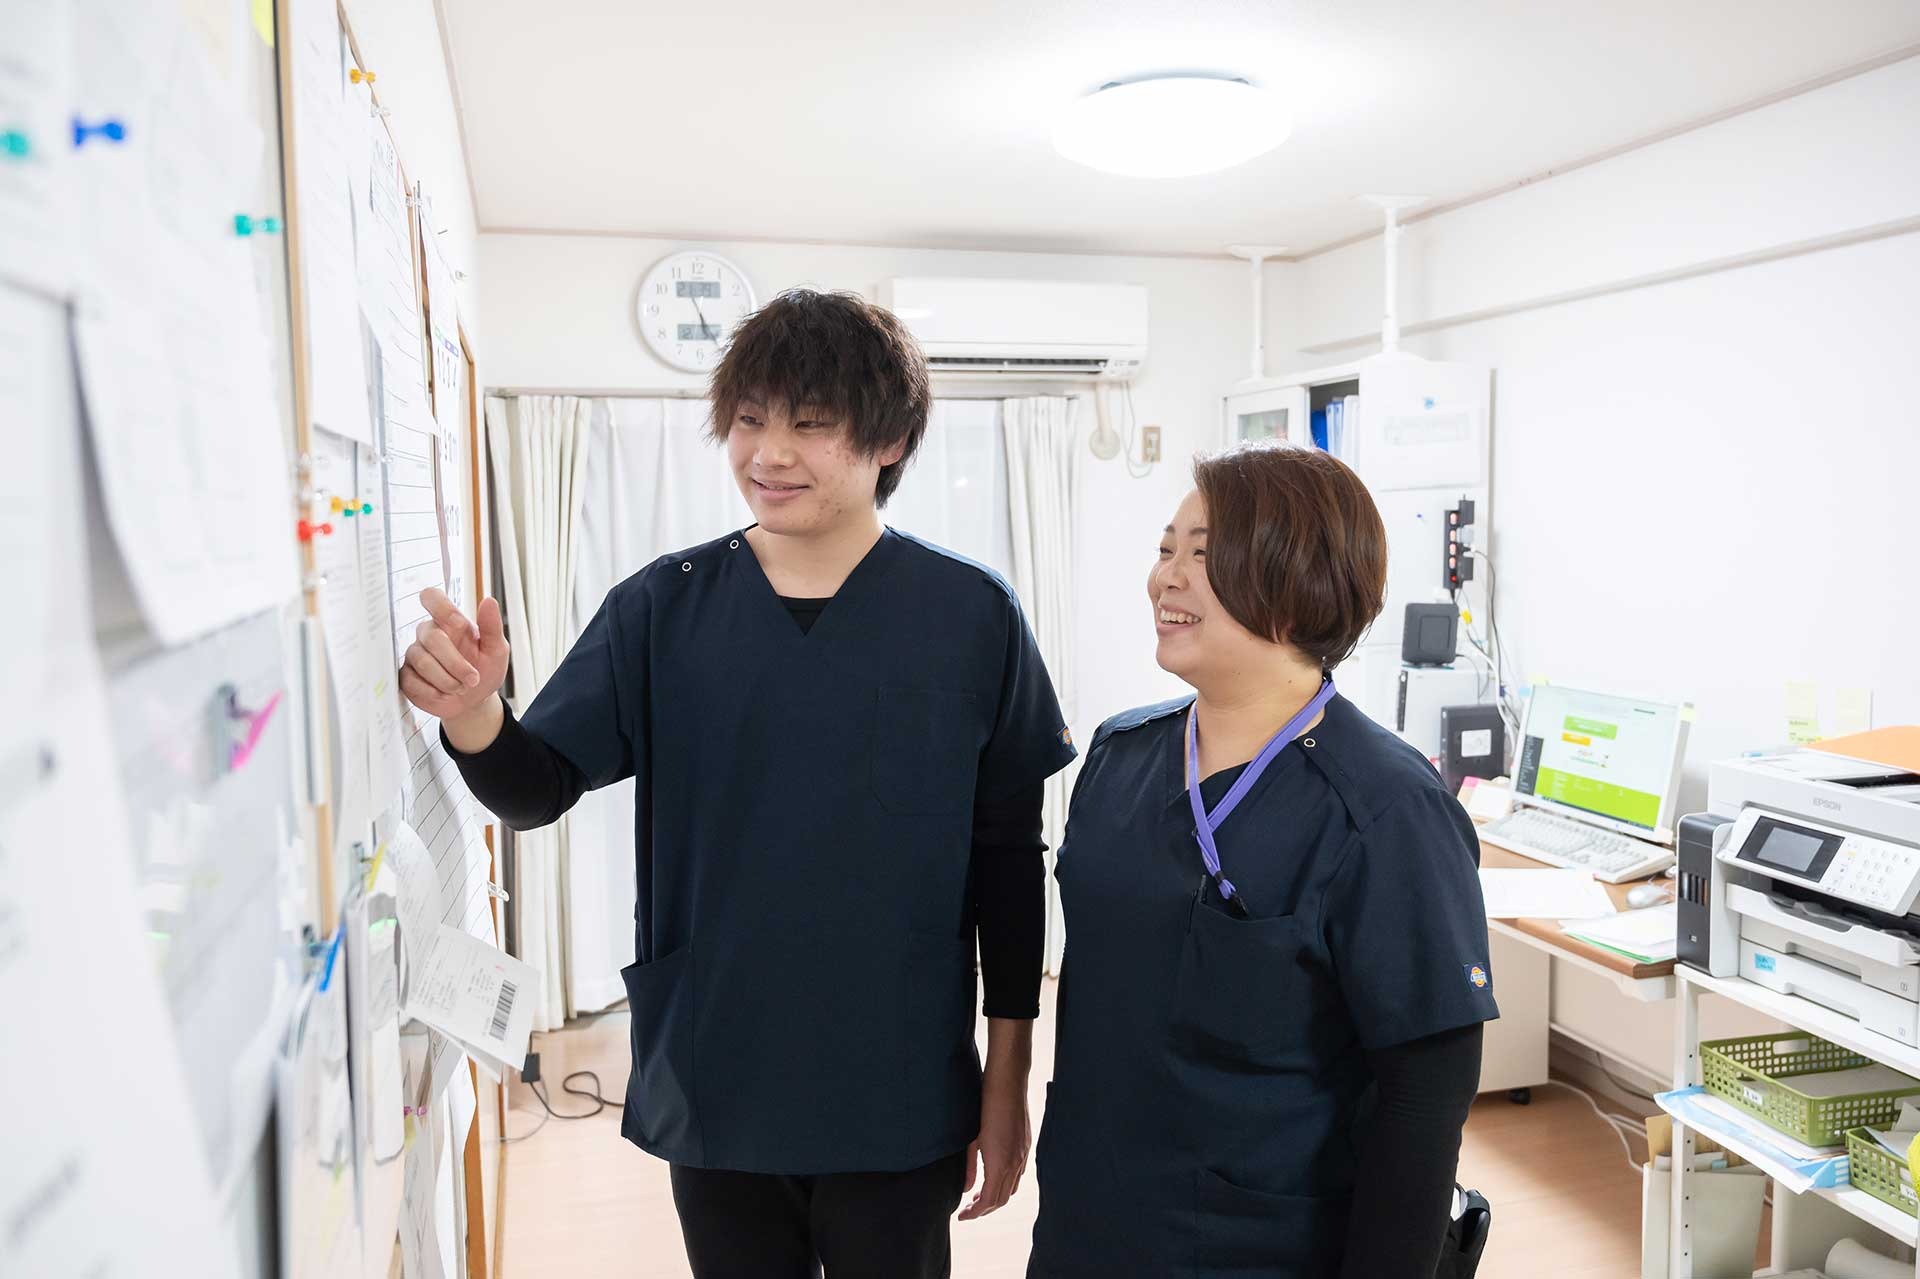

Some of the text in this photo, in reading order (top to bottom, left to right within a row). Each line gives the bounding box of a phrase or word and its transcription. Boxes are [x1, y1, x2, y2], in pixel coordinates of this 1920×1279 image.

[691, 262, 705, 275] 12
[656, 282, 668, 295] 10
[1812, 797, 1841, 811] EPSON
